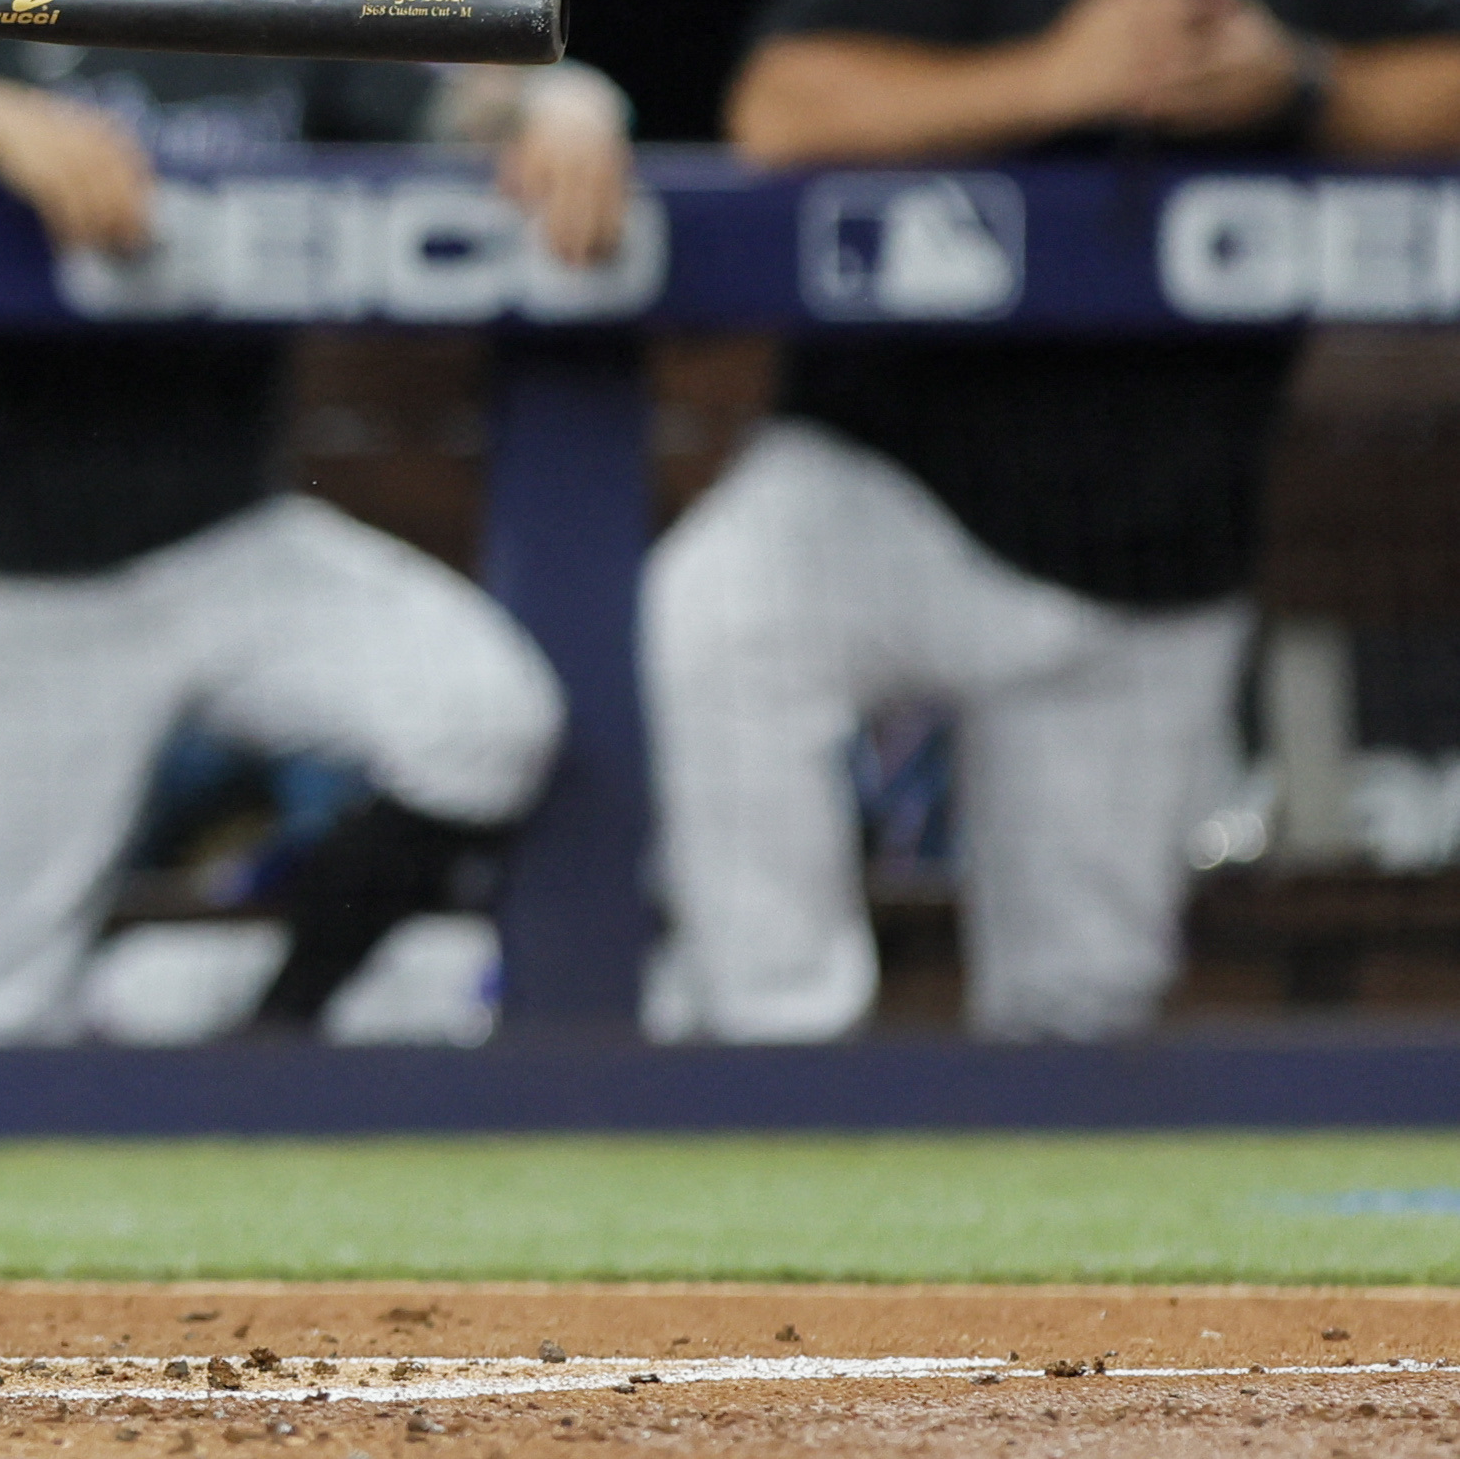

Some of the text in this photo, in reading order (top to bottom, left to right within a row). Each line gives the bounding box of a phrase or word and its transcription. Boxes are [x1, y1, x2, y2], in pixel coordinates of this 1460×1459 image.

[359, 4, 386, 19] JS68
[388, 5, 428, 16] Custom
[431, 6, 450, 16] Cut
